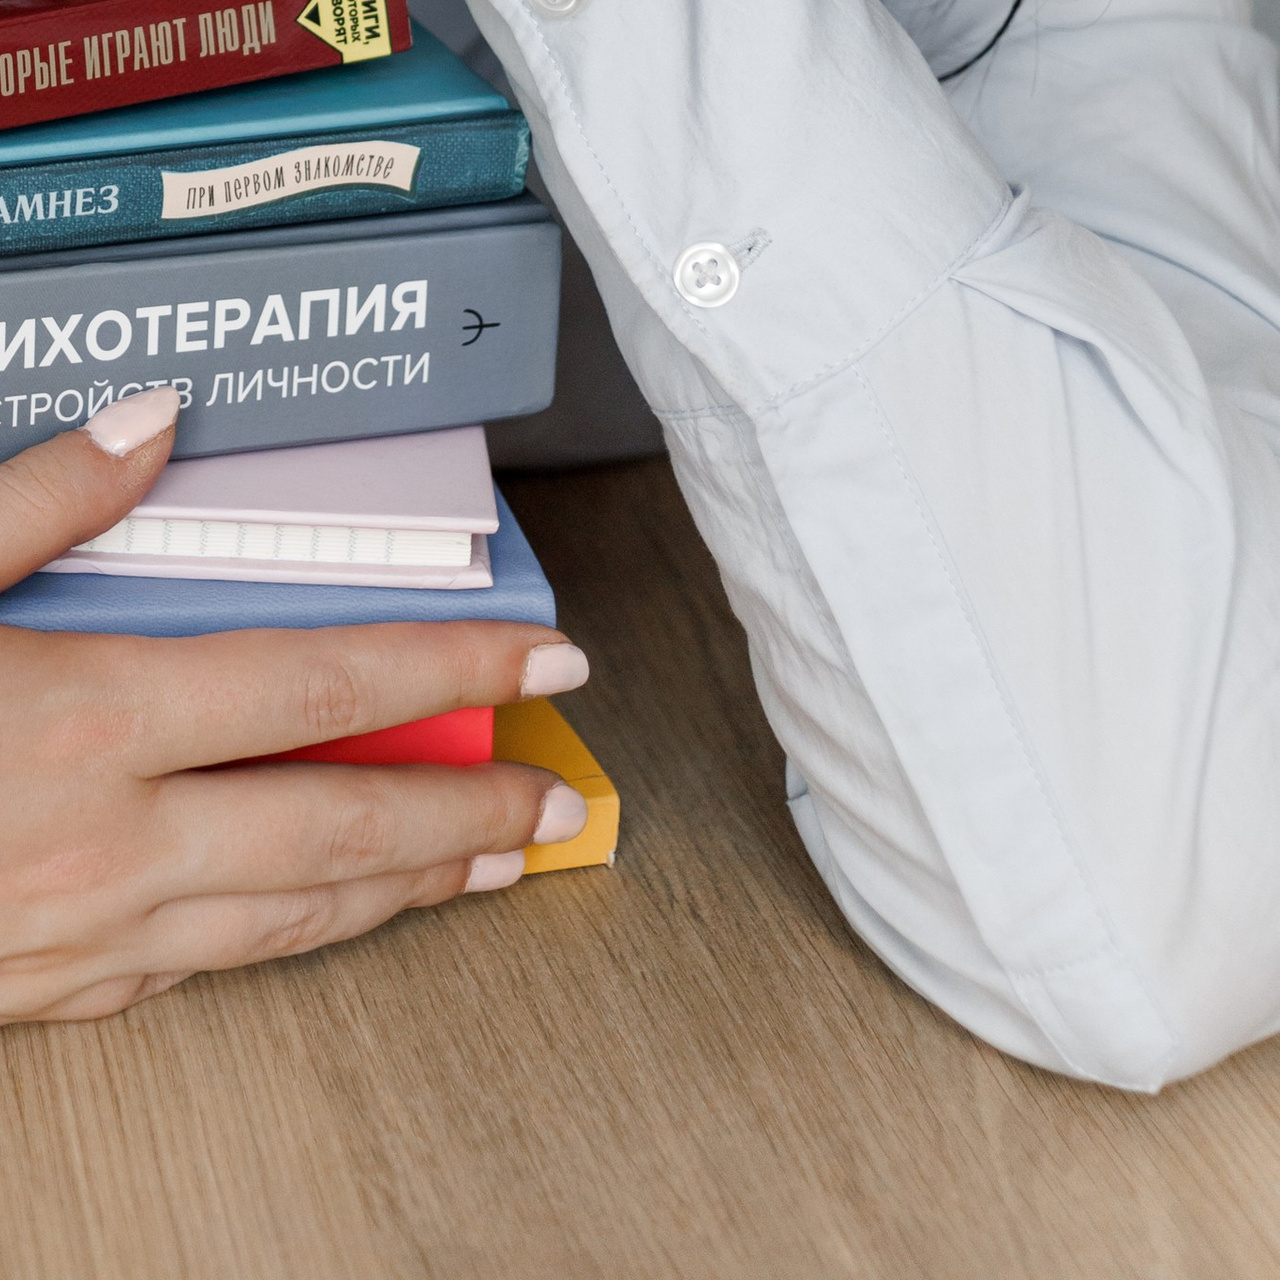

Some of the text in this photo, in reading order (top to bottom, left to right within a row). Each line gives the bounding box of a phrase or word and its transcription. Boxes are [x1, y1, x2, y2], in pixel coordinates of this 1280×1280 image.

[83, 23, 187, 81] ИГРАЮТ
[199, 0, 277, 58] ЛЮДИ
[206, 352, 430, 405] ЛИЧНОСТИ
